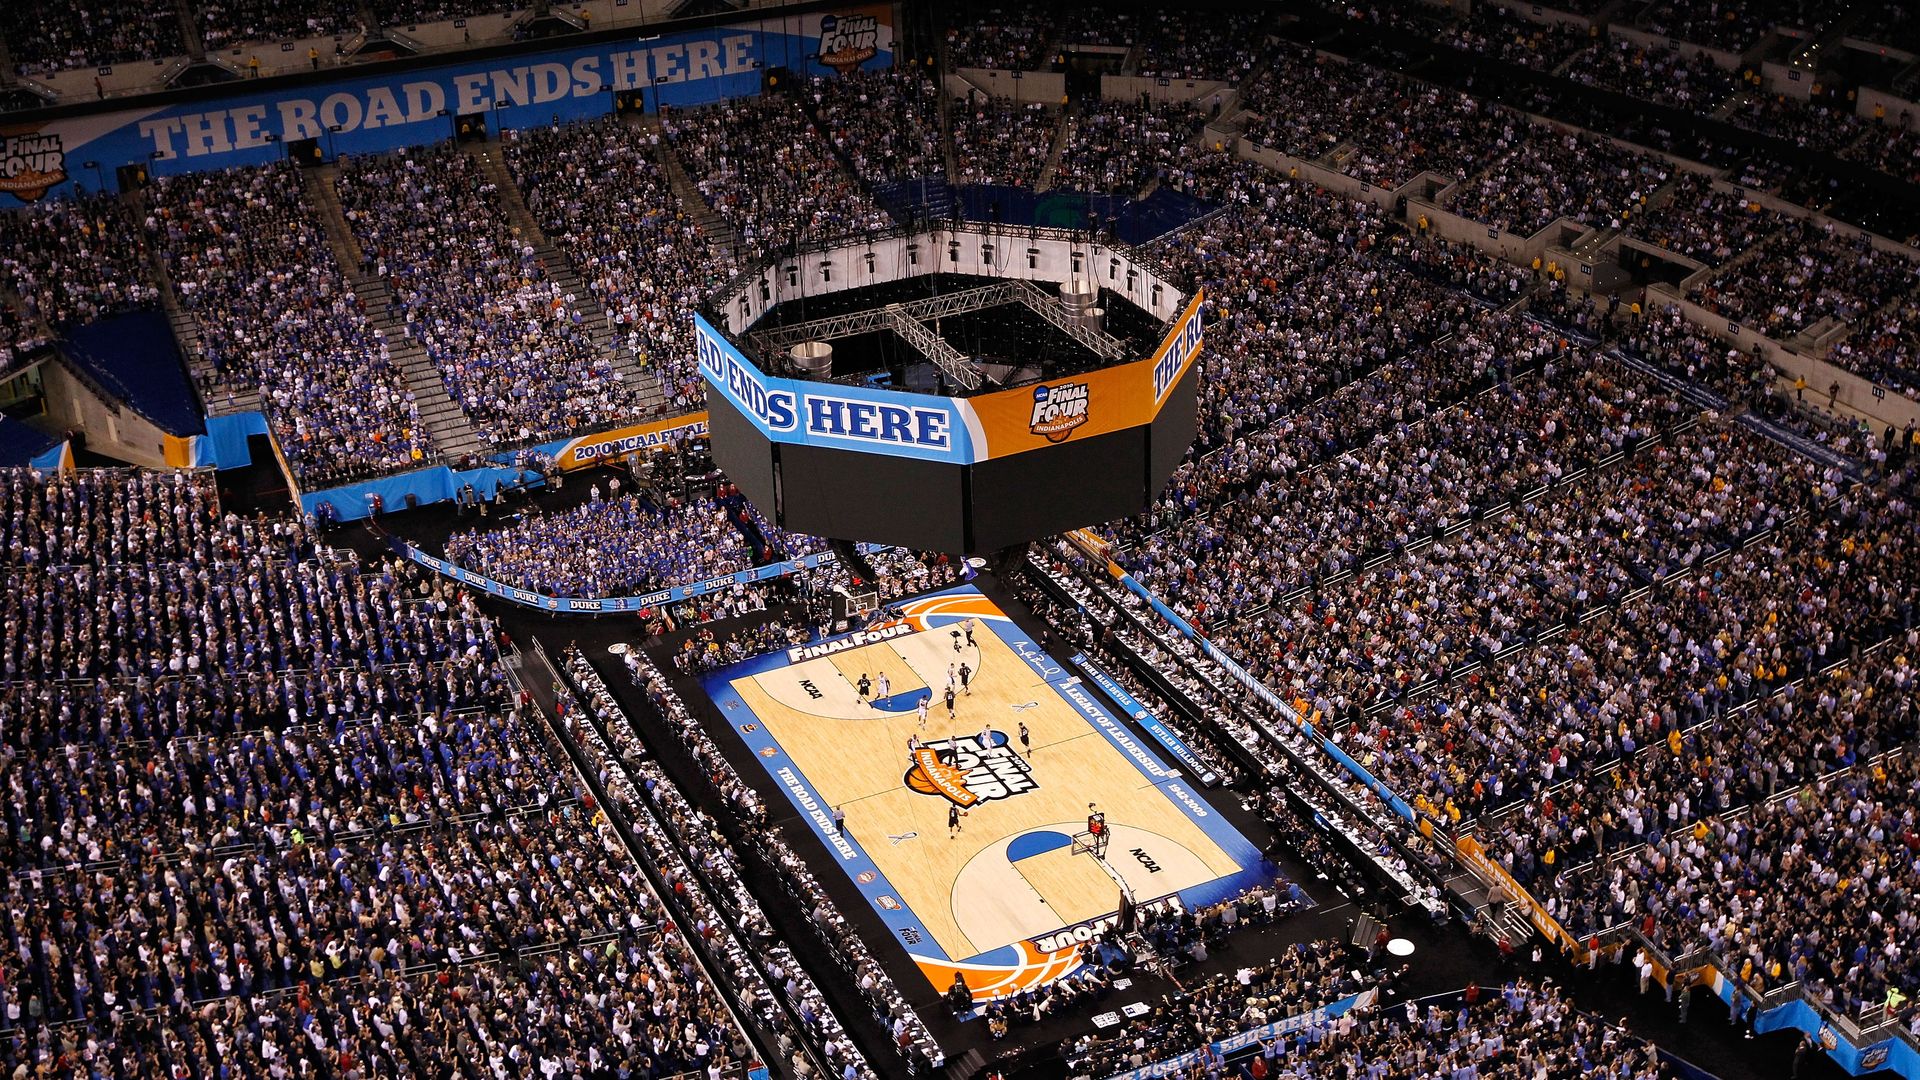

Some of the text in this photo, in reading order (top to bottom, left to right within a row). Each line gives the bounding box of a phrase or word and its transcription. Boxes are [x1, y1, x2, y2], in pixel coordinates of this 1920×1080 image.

[836, 18, 876, 35] FINAL
[819, 31, 876, 55] FOUR
[140, 34, 755, 160] THE ROAD ENDS HERE
[6, 137, 60, 157] FINAL
[1154, 330, 1184, 402] THE
[726, 356, 797, 430] ENDS
[806, 397, 948, 448] HERE
[1048, 385, 1087, 404] FINAL
[1031, 399, 1087, 426] FOUR
[1036, 416, 1083, 431] INDIANAPOLIS
[576, 422, 706, 459] 2010 NCAA FIAL
[421, 555, 441, 569] DUKE
[465, 573, 486, 587] DUKE
[705, 575, 735, 591] DUKE
[513, 590, 538, 603] DUKE
[570, 600, 601, 610] DUKE
[640, 591, 670, 606] DUKE
[788, 636, 854, 662] FINAL
[852, 623, 912, 646] FOUR
[799, 679, 823, 699] NCAA
[1081, 661, 1132, 706] DUKE BLUE DEVILS
[1059, 682, 1167, 777] A LEGACY OF LEADERSHIP
[1150, 724, 1206, 774] BUTLER BULLDOGS
[928, 738, 1008, 798] FOUR
[976, 746, 1035, 793] FINAL
[1012, 755, 1028, 771] 2010
[920, 752, 973, 801] INDIANAPOLIS
[777, 767, 858, 860] THE ROAD ENDS HERE
[1168, 783, 1208, 818] 1942-2009
[1129, 848, 1162, 873] NCAA
[898, 928, 917, 945] FOUR
[1036, 920, 1106, 951] FOUR
